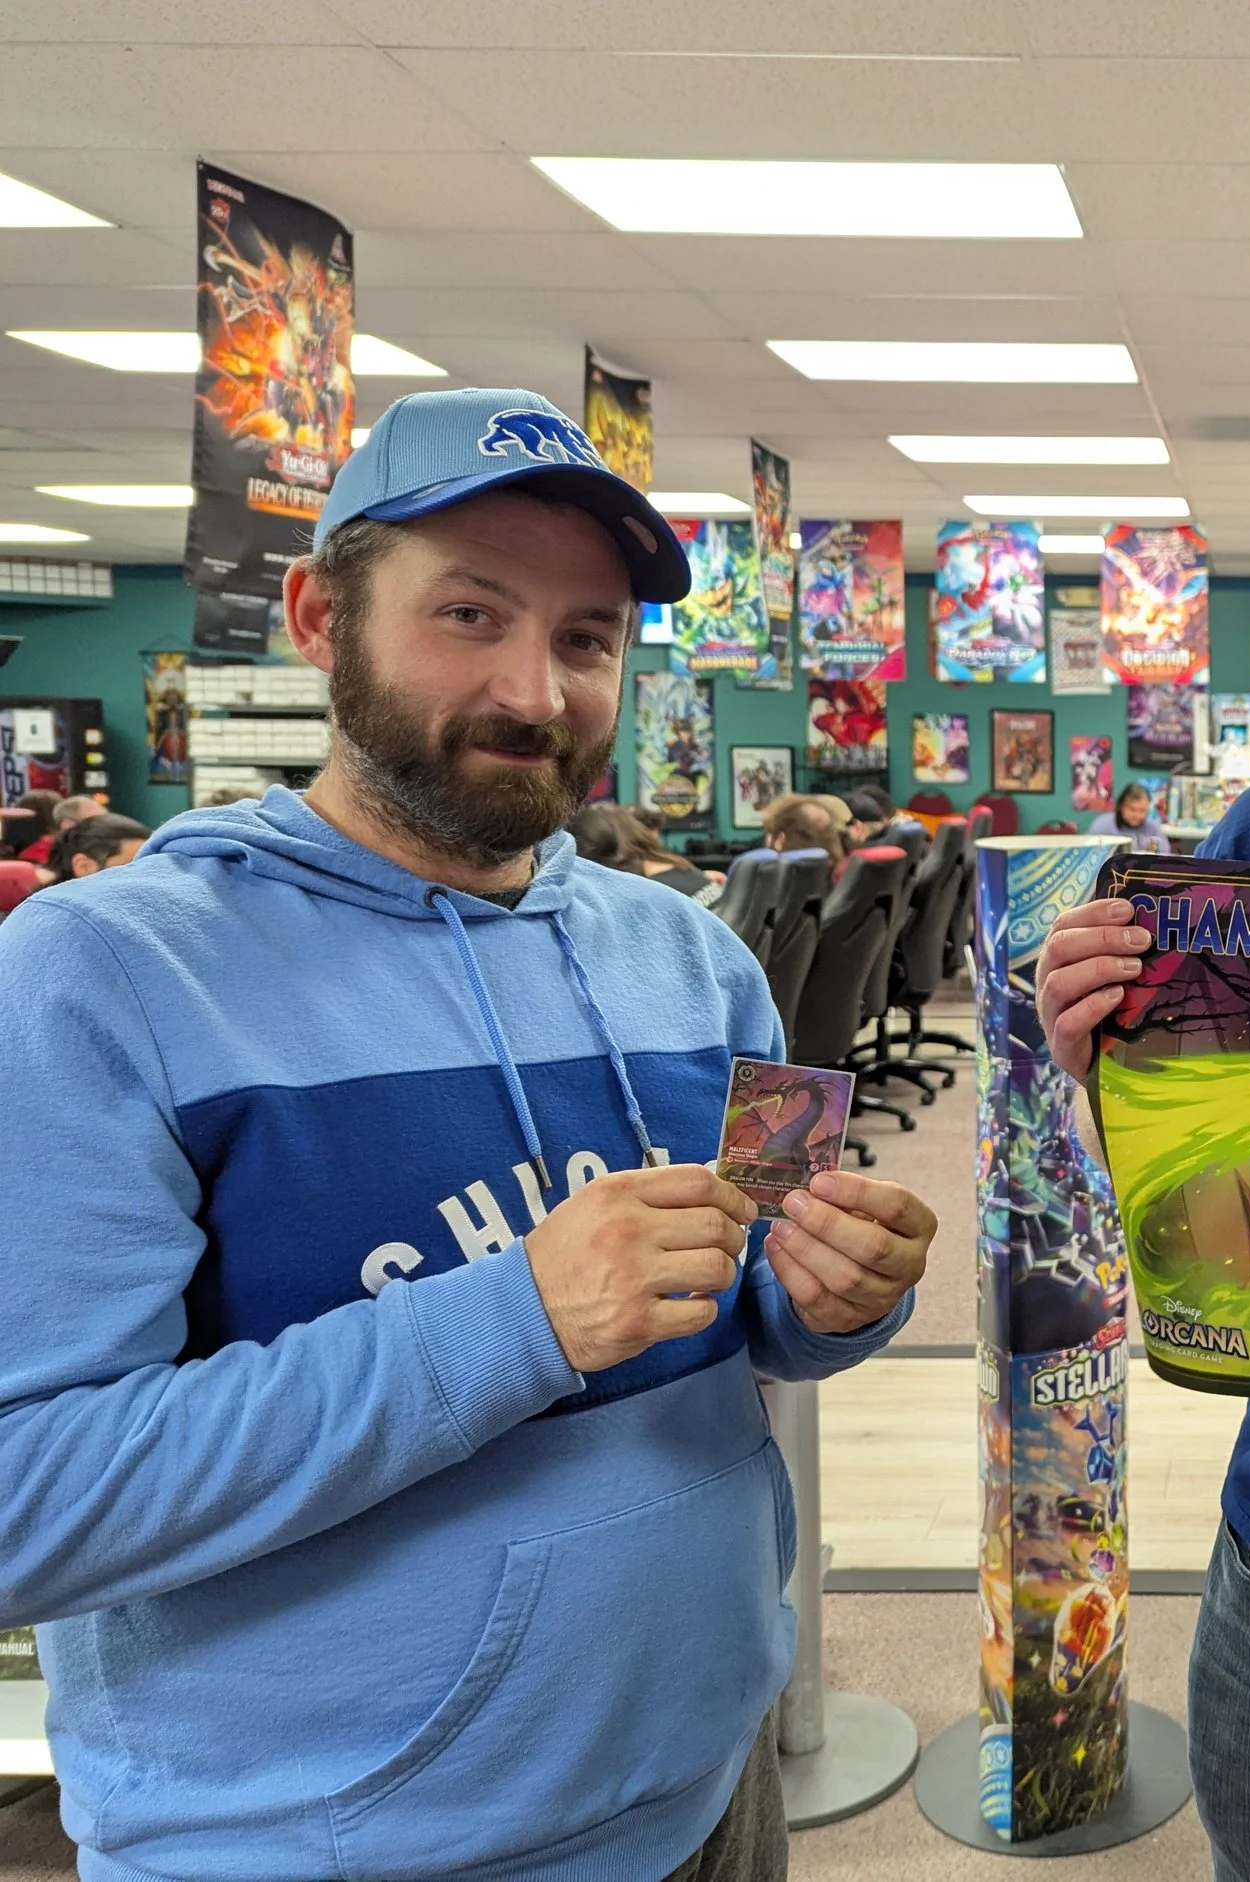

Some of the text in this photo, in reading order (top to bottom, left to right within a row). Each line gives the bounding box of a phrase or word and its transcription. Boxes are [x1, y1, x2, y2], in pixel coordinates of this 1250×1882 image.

[728, 1146, 758, 1154] MALEFICENT
[1161, 1295, 1202, 1321] Disney
[1176, 1348, 1198, 1358] CARD
[1199, 1353, 1223, 1364] GAME
[0, 1643, 34, 1656] ANUAL
